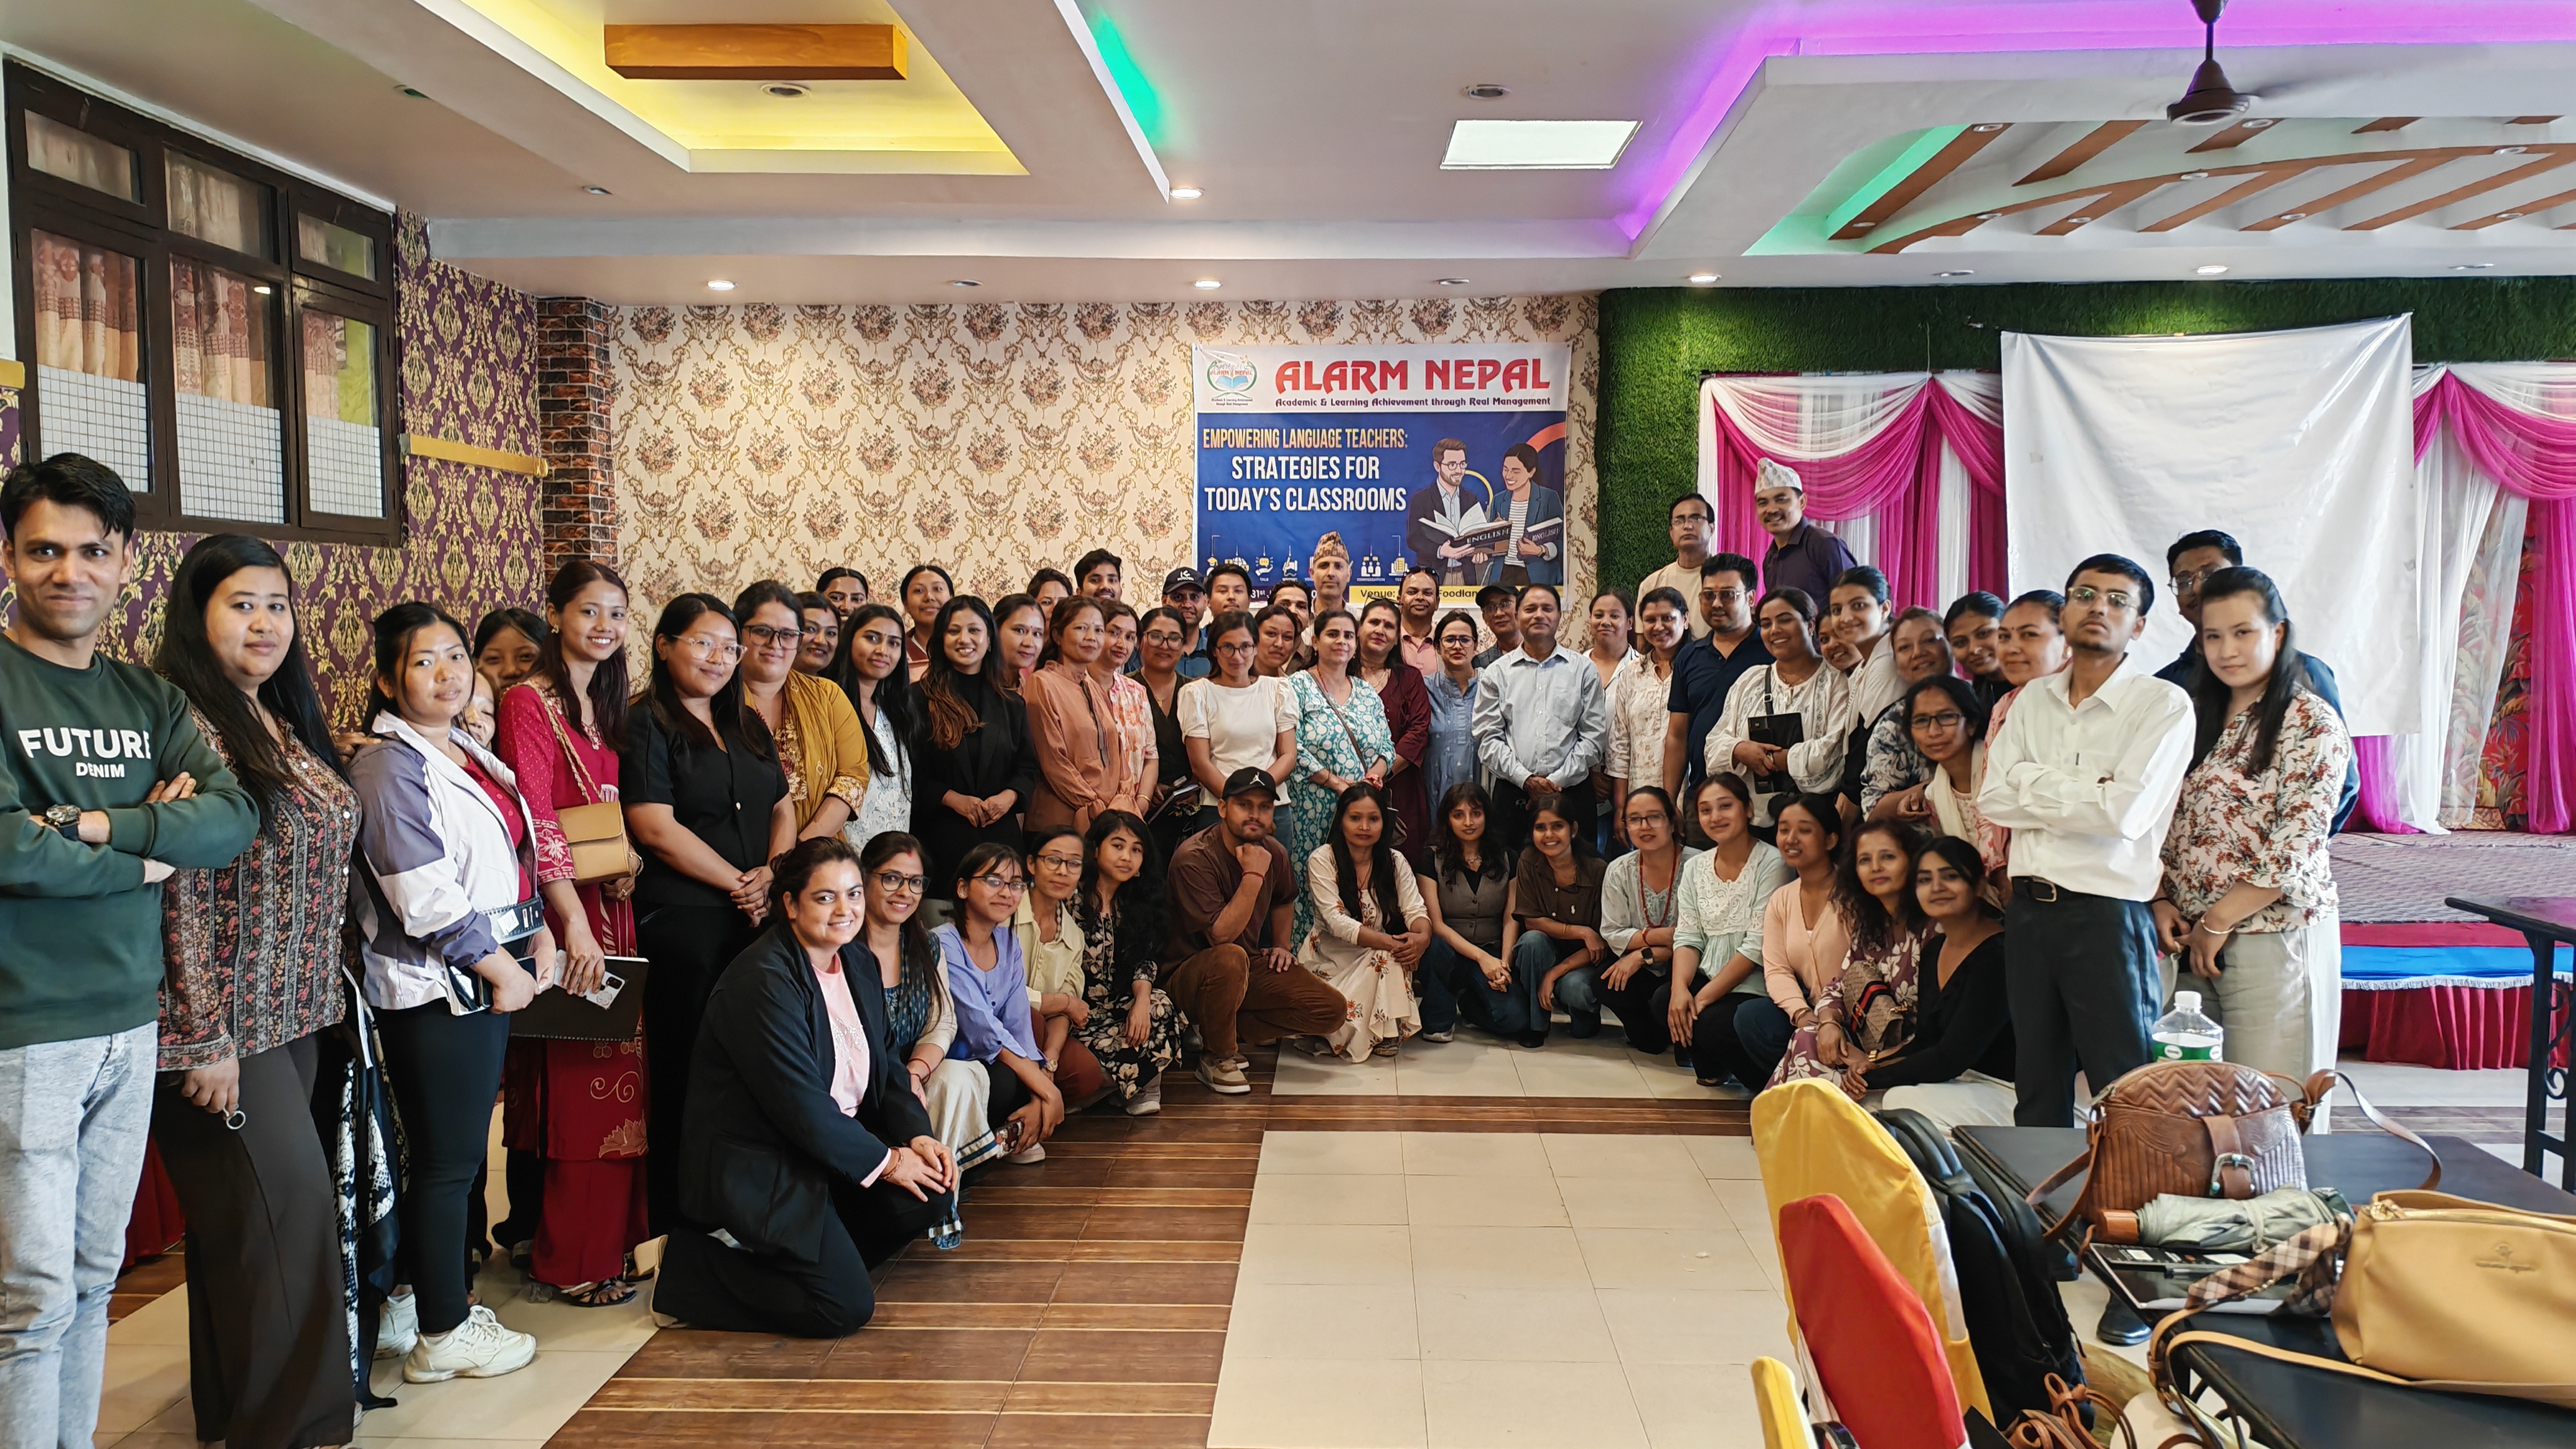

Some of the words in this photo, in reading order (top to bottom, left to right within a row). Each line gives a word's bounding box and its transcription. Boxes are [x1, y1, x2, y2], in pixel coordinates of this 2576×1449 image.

[1275, 360, 1408, 394] ALARM
[1425, 358, 1550, 393] NEPAL
[1275, 398, 1317, 407] Academic
[1331, 398, 1368, 408] Learning
[1372, 397, 1428, 407] Achievement
[1431, 397, 1466, 407] through
[1469, 397, 1489, 406] Real
[1493, 397, 1550, 407] Management
[1202, 428, 1279, 448] EMPOWERING
[1283, 428, 1342, 448] LANGUAGE
[1345, 428, 1408, 448] TEACHERS:
[1231, 456, 1340, 479] STRATEGIES
[1345, 456, 1380, 479] FOR
[1204, 487, 1281, 511] TODAY’S
[1285, 487, 1406, 511] CLASSROOMS
[1467, 528, 1509, 543] ENGLISH
[1360, 589, 1395, 598] Venue:
[1440, 589, 1478, 597] oodlan
[75, 762, 125, 778] DENIM
